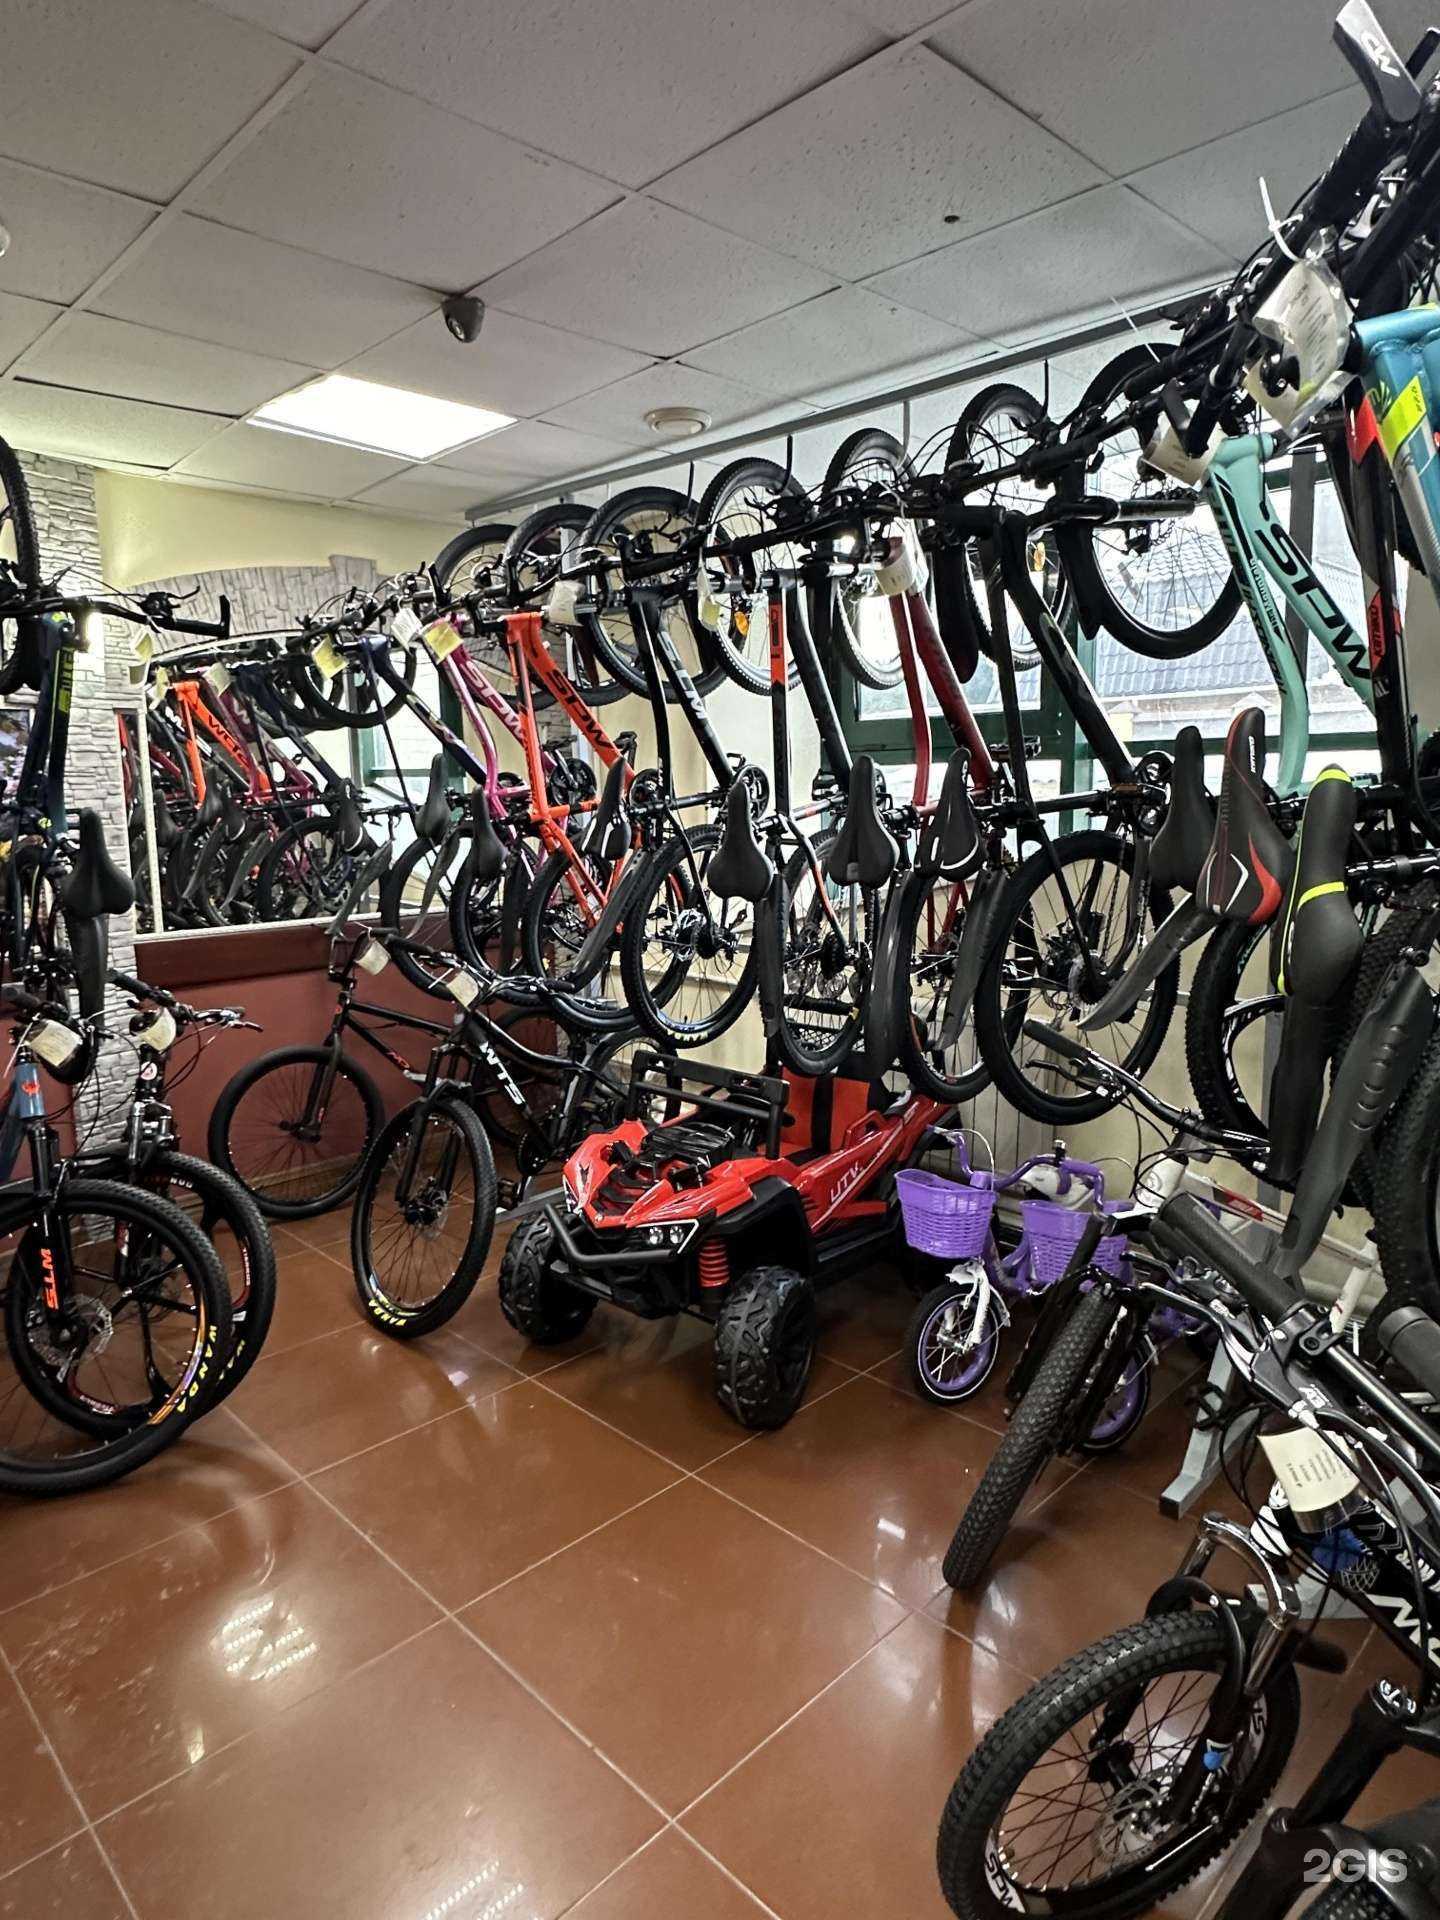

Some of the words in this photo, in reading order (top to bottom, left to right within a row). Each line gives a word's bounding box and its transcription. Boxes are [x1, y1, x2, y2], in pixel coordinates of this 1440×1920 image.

[1254, 523, 1371, 679] SPW
[546, 669, 613, 749] SPW
[479, 1041, 526, 1104] WTS
